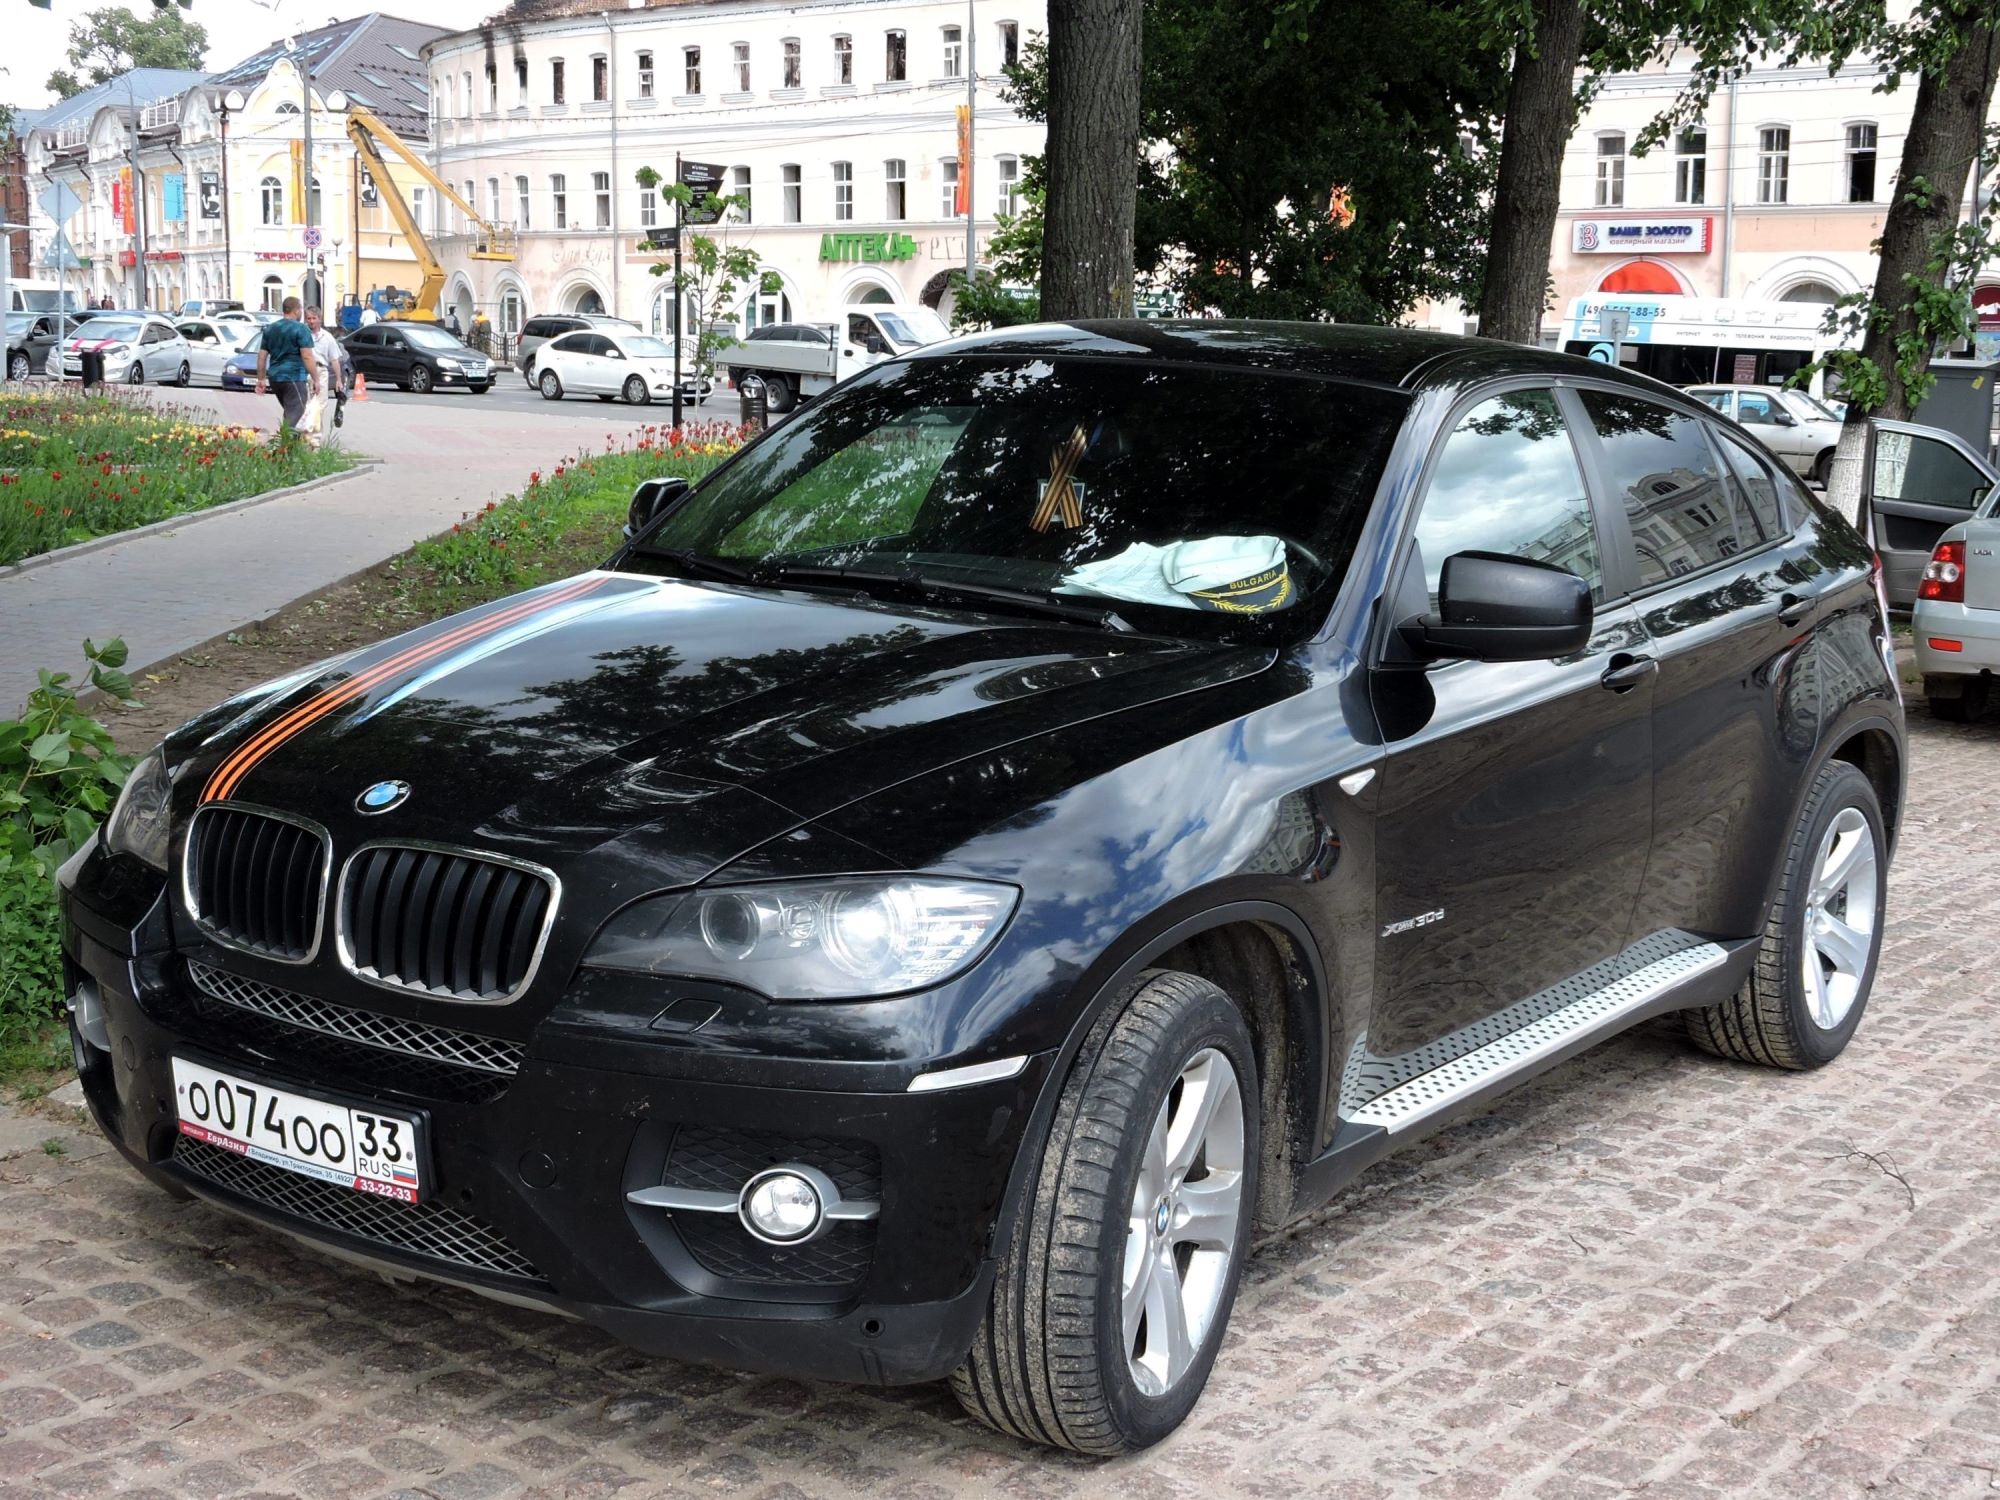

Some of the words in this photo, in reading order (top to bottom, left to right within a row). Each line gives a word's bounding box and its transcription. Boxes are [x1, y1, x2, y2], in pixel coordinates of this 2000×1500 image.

[1608, 226, 1643, 237] ВАШЕ
[1645, 226, 1693, 236] ЗОЛОТО
[1653, 238, 1686, 246] магазин
[818, 232, 903, 262] АПТЕКА
[1229, 569, 1277, 590] BULGARIA
[356, 1114, 402, 1163] 33
[359, 1157, 391, 1178] RUS
[360, 1179, 412, 1201] 33-22-33
